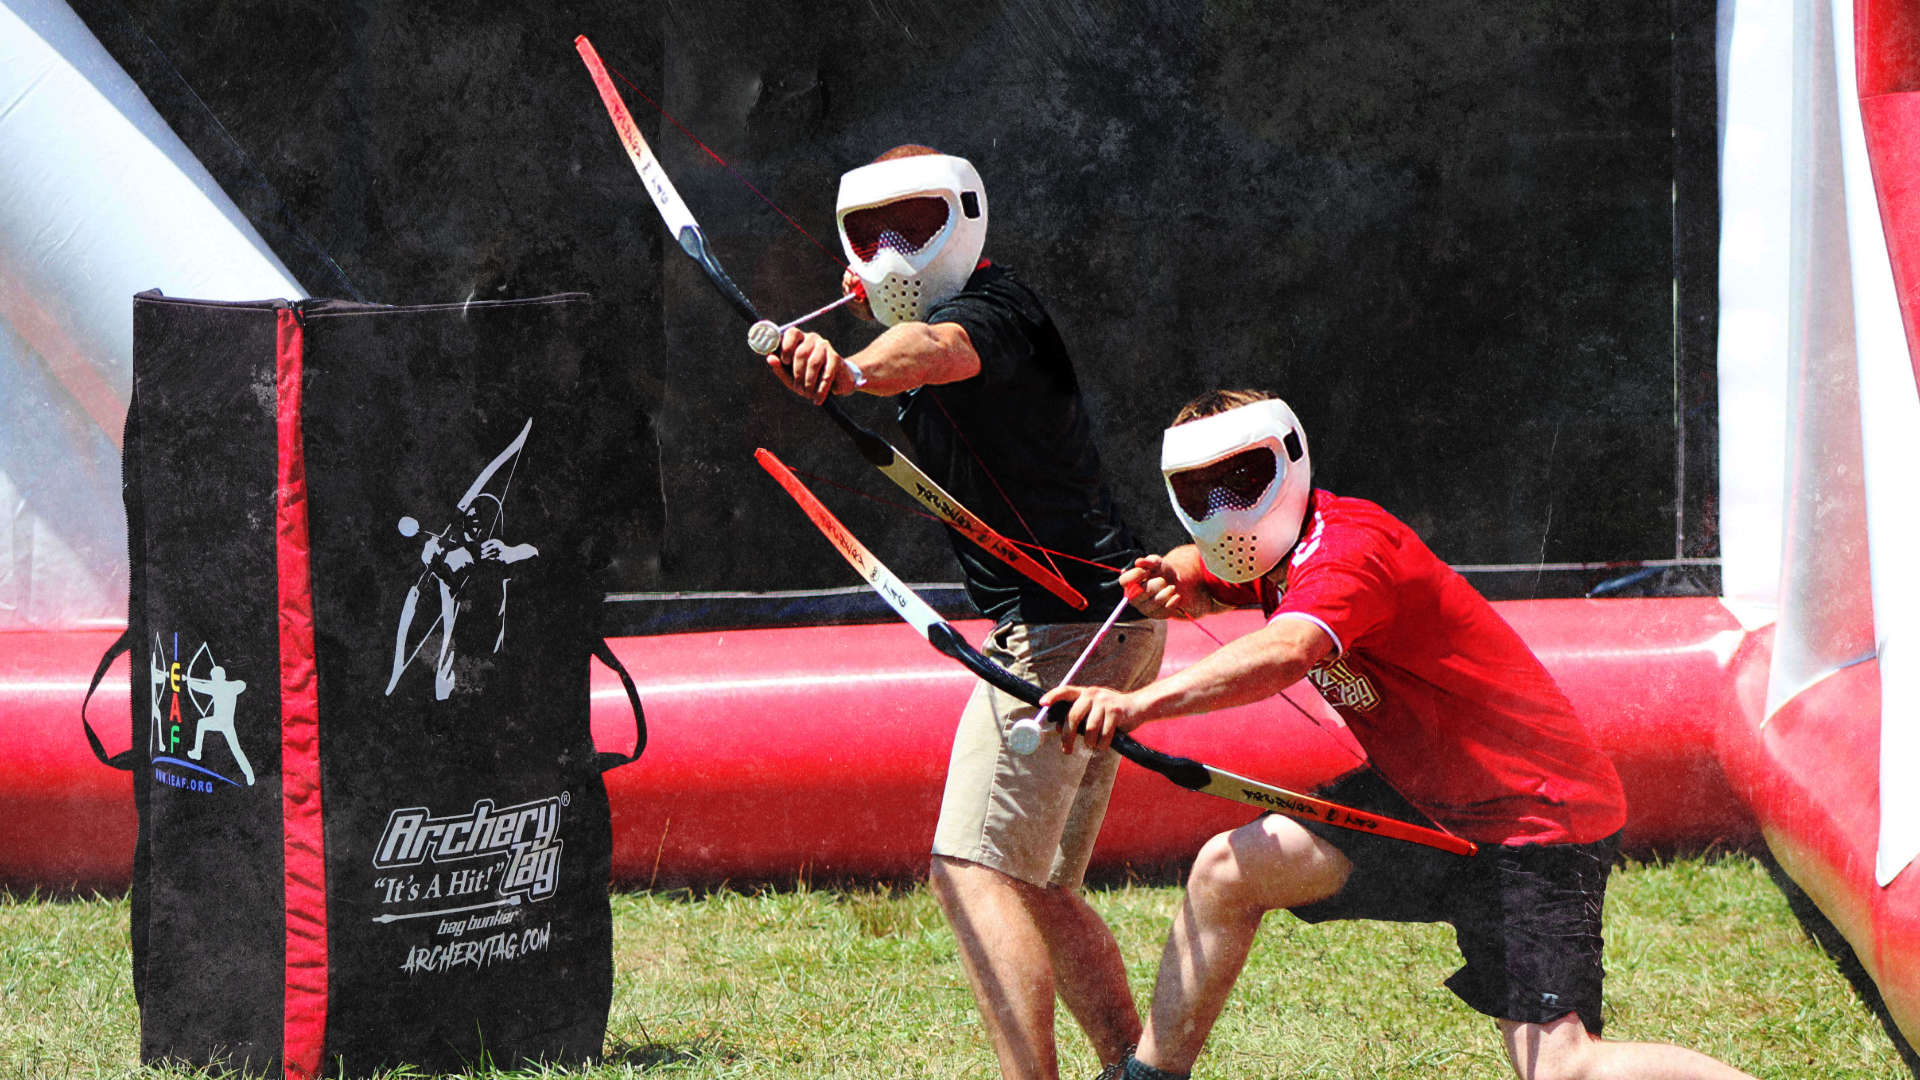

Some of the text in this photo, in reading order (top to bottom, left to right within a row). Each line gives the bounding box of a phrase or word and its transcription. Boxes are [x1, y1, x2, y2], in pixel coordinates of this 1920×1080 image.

[883, 579, 907, 608] TAG
[169, 631, 182, 754] IEAF
[378, 803, 558, 862] Archery
[422, 873, 442, 900] A
[504, 840, 561, 896] Tag
[399, 921, 551, 976] ARCHERYTAG.COM
[437, 909, 517, 937] bag bunker
